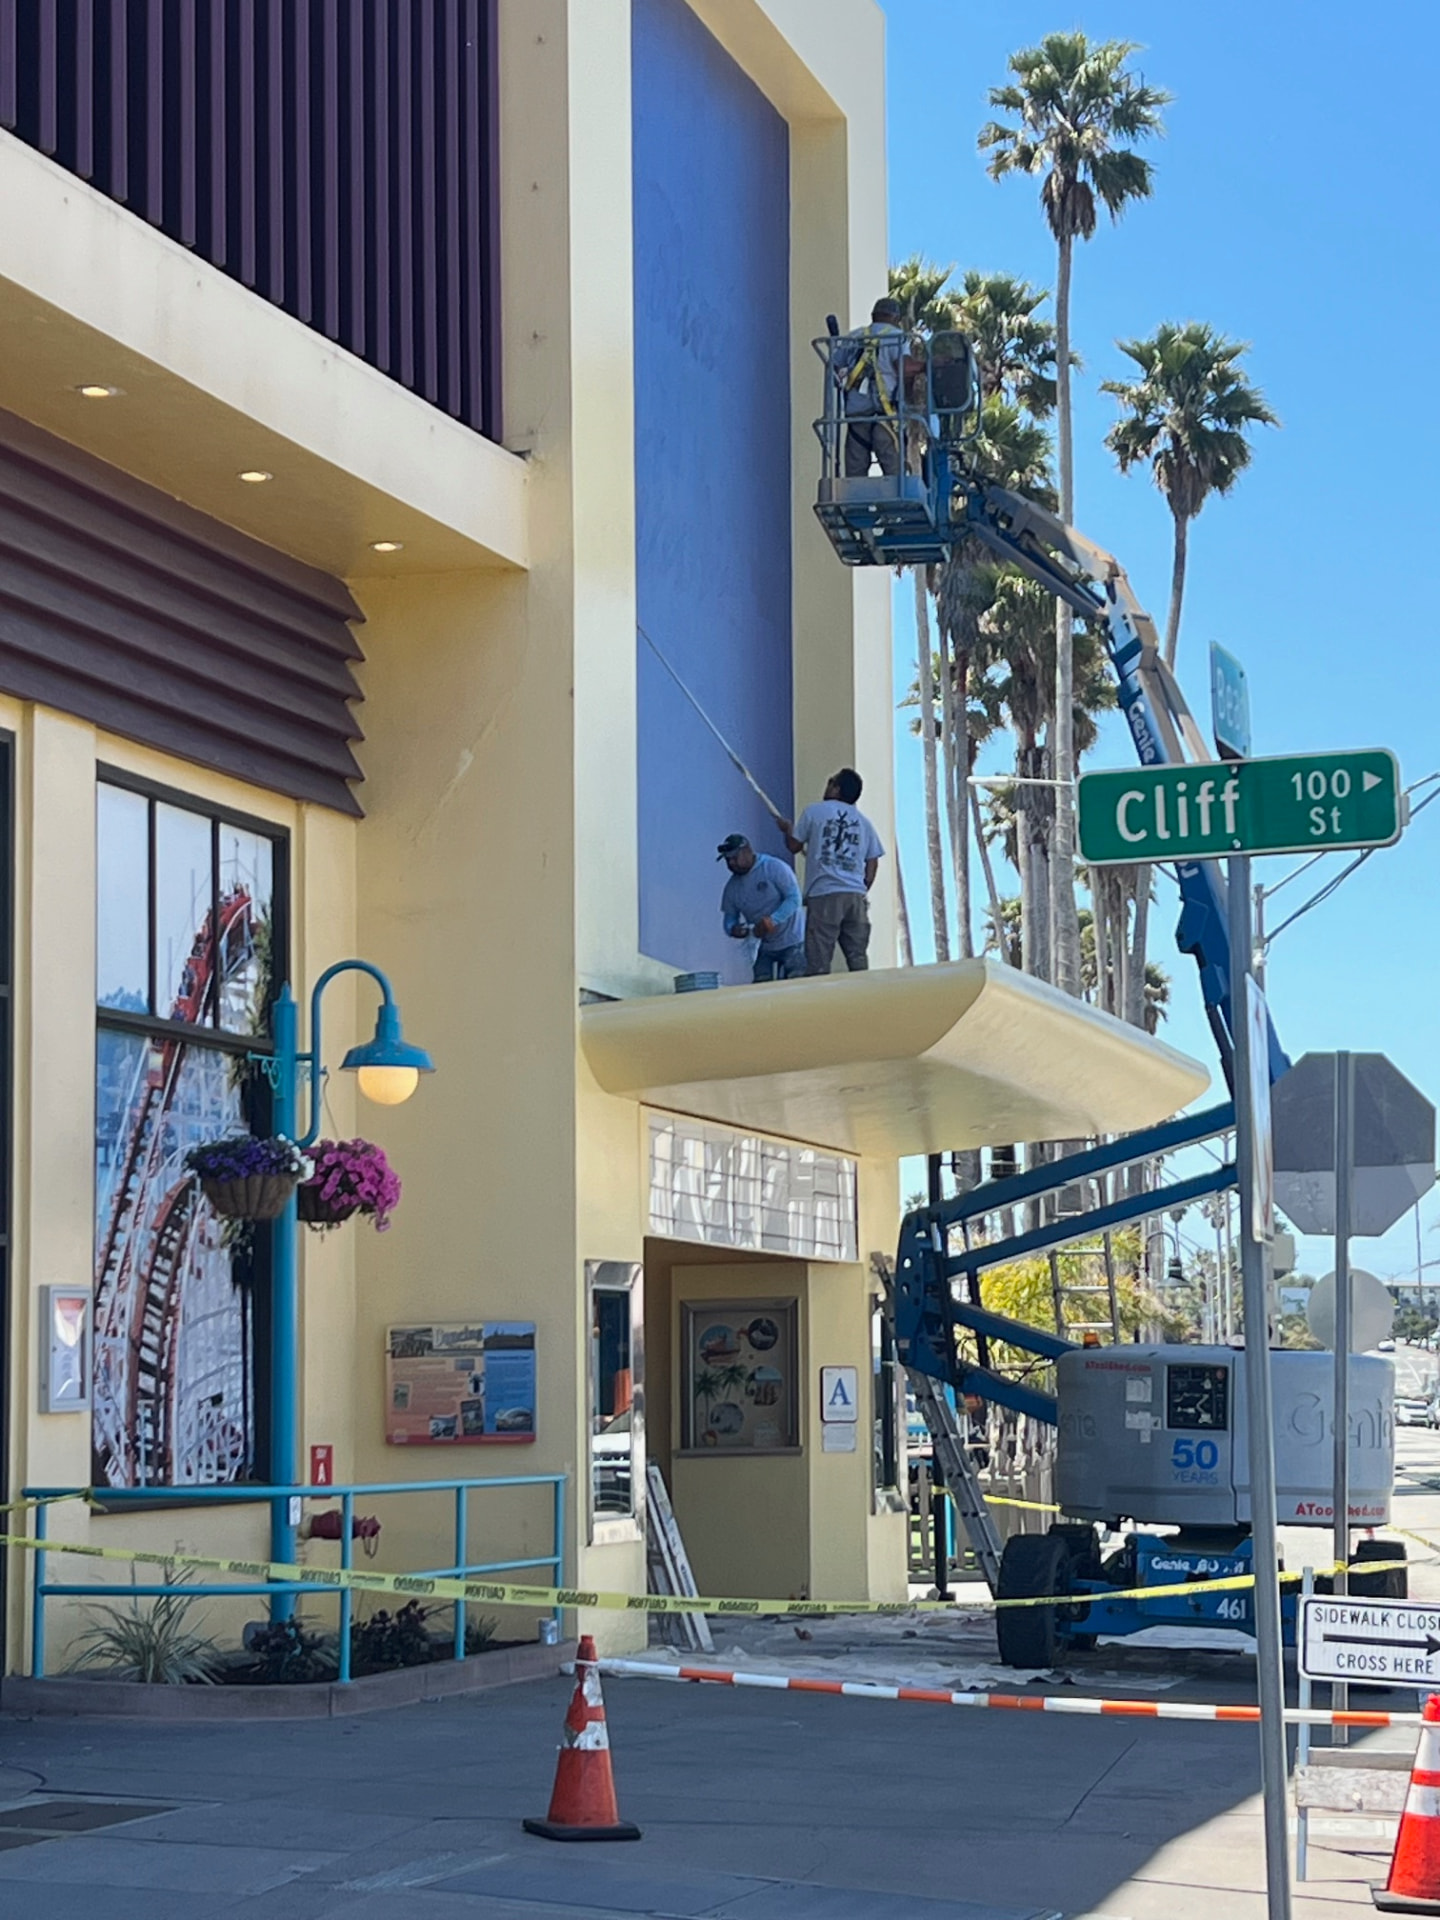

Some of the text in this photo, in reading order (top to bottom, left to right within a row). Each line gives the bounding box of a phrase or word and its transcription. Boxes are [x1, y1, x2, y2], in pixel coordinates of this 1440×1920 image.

[1291, 769, 1351, 801] 100
[1116, 779, 1240, 842] Cliff
[1309, 806, 1342, 836] St
[828, 1377, 852, 1406] A
[1171, 1438, 1218, 1470] 50
[1173, 1471, 1219, 1485] YEARS
[1295, 1502, 1385, 1517] AToohed.com
[1216, 1598, 1246, 1619] 461
[1314, 1607, 1390, 1628] SIDEWALK
[1336, 1652, 1434, 1674] CROSS HERE
